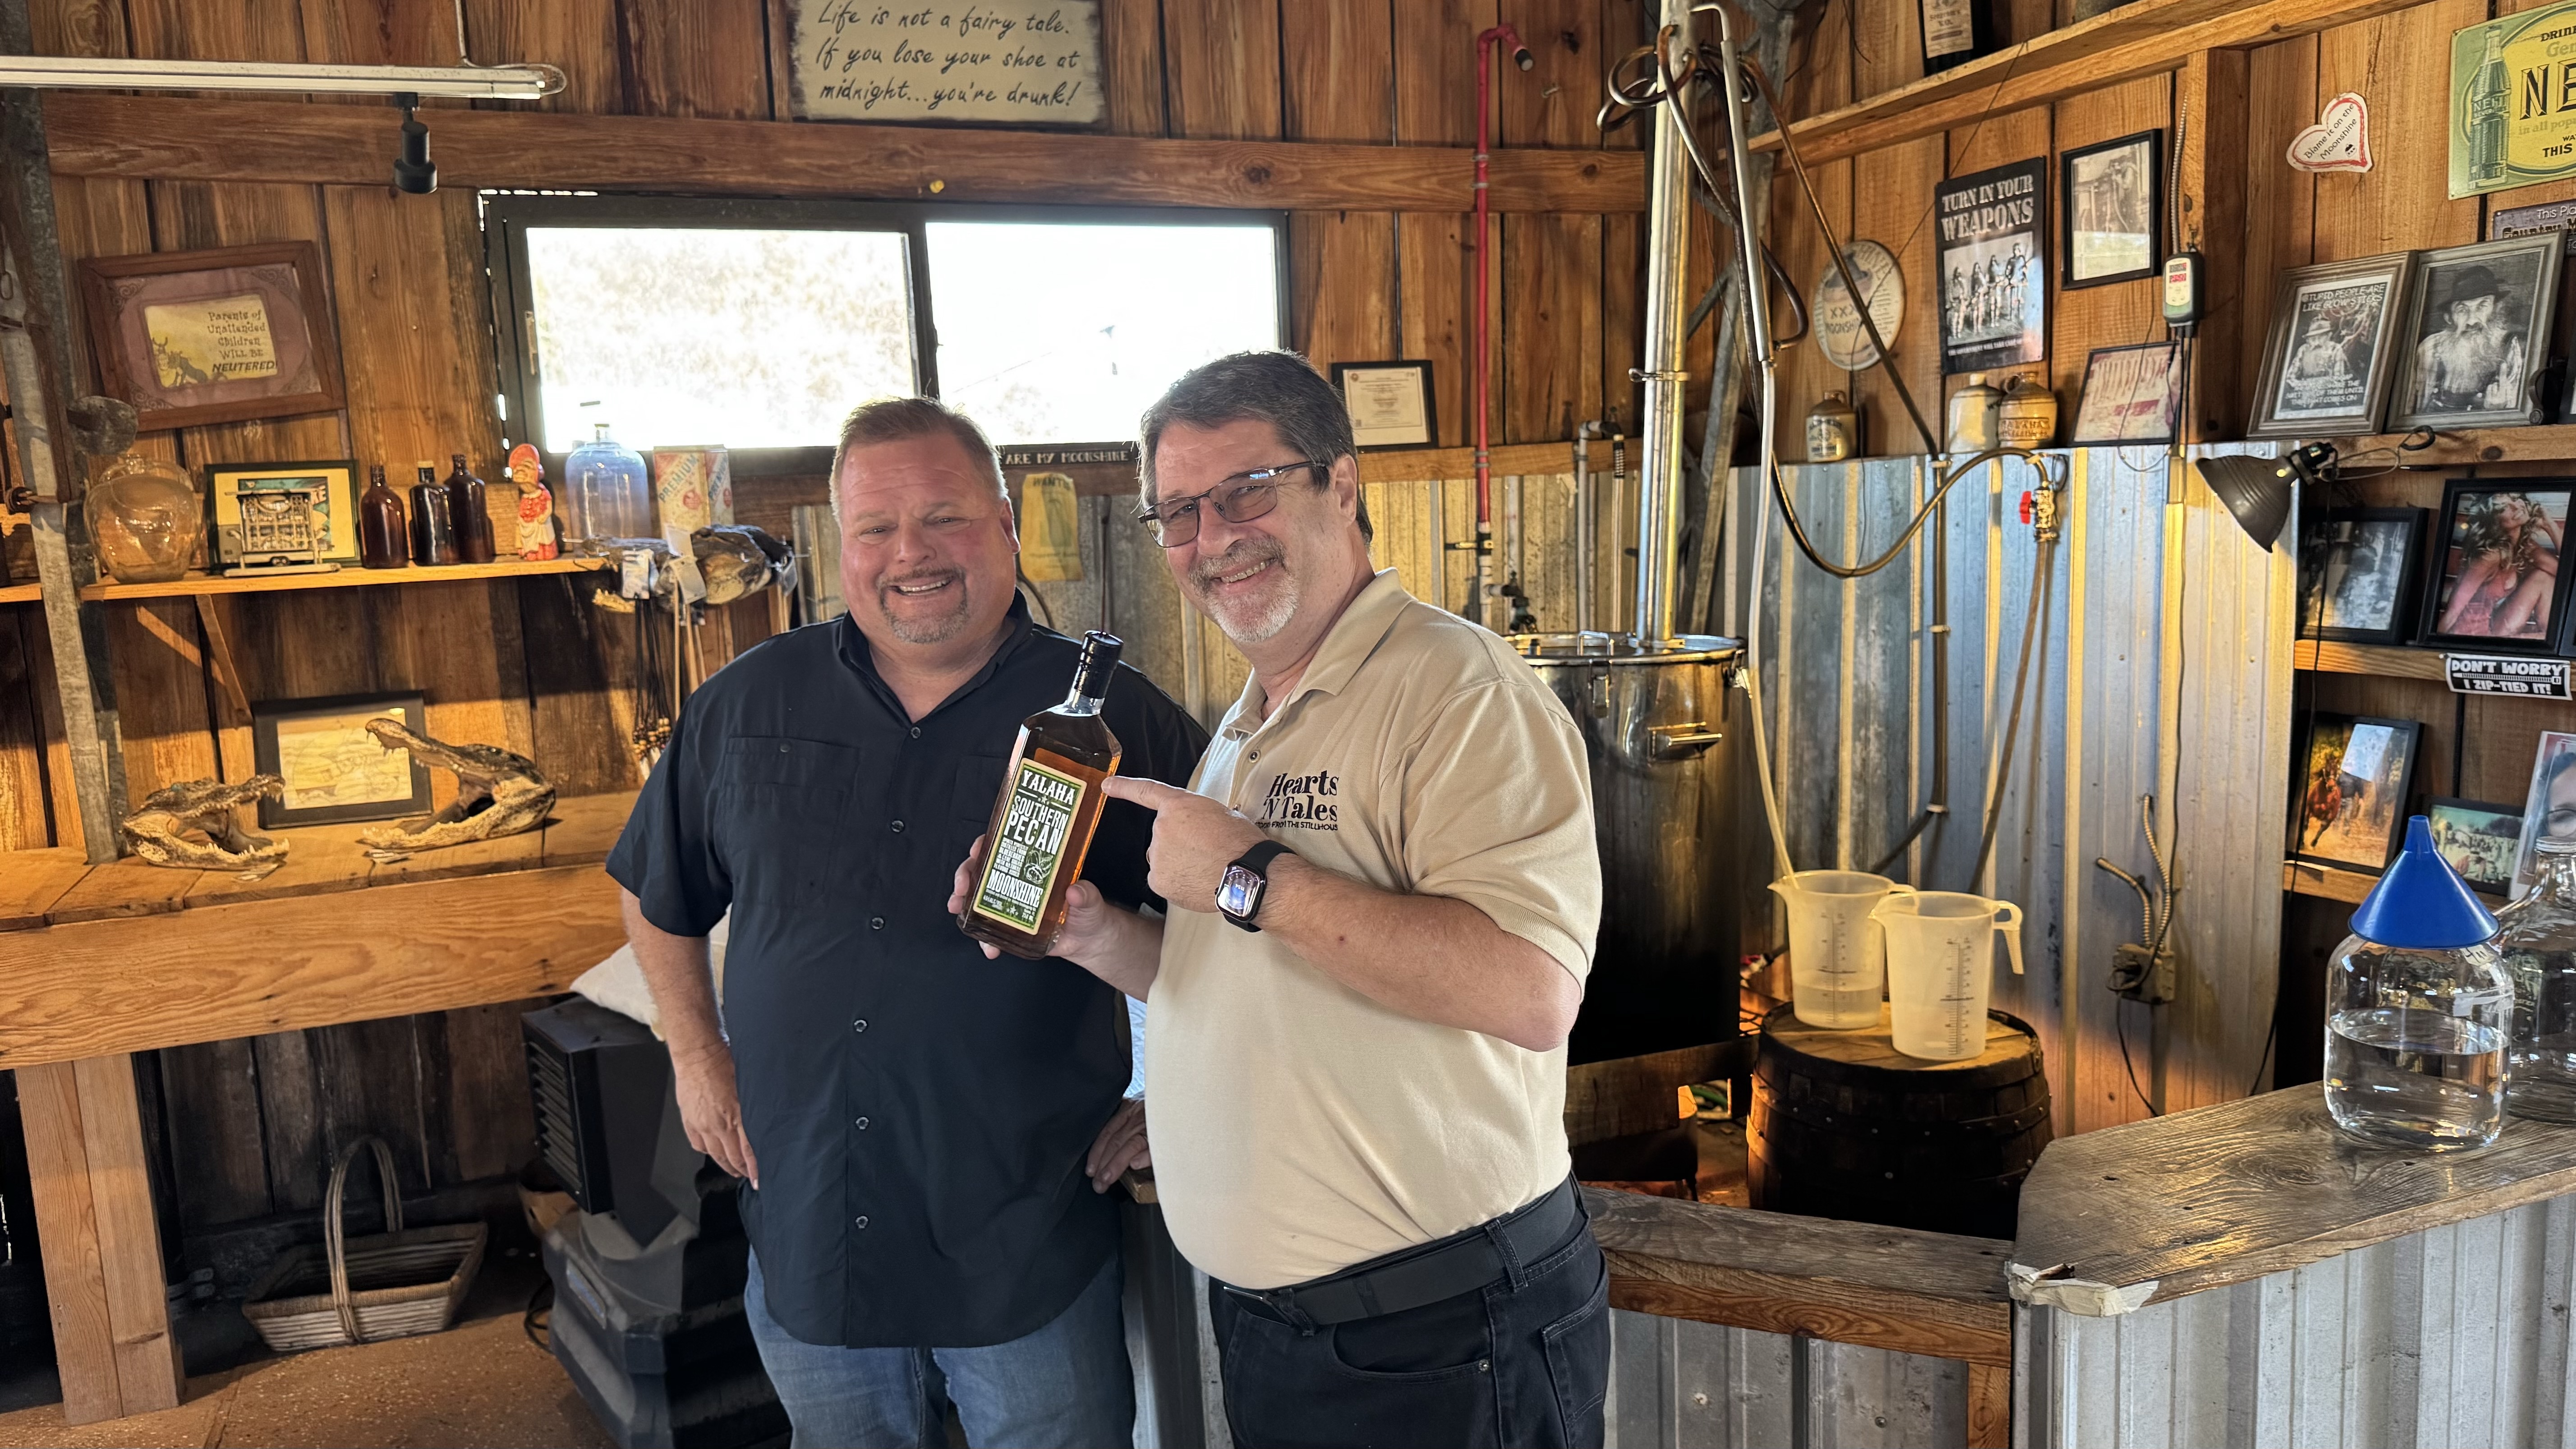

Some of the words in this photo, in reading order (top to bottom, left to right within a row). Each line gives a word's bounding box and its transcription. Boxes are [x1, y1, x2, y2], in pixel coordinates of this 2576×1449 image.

[818, 0, 860, 34] Life
[871, 7, 889, 24] is
[898, 9, 933, 28] not
[941, 15, 950, 28] a
[960, 5, 1016, 40] fairy
[1026, 10, 1069, 33] tale.
[816, 37, 840, 71] If
[843, 49, 882, 73] you
[894, 39, 934, 63] lose
[941, 52, 991, 74] your
[1003, 46, 1046, 68] shoe
[1057, 51, 1081, 68] at
[1007, 81, 1081, 106] drunk!
[2304, 136, 2327, 159] Blame
[2333, 118, 2343, 129] on
[2343, 104, 2354, 117] the
[2320, 119, 2357, 160] Moonshine
[2542, 143, 2572, 157] THIS
[1942, 188, 1977, 212] TURN
[1979, 184, 1994, 203] IN
[1996, 175, 2034, 199] YOUR
[1941, 197, 2034, 241] WEAPONS
[208, 311, 248, 321] Parents
[252, 309, 261, 320] of
[2302, 302, 2322, 312] LIKE
[207, 322, 265, 335] Unattended
[218, 336, 261, 346] Children
[219, 349, 247, 359] WILL
[250, 349, 263, 358] BE
[1005, 454, 1031, 465] ARE
[1037, 453, 1055, 464] MY
[1061, 451, 1128, 463] MOONSHINE
[658, 454, 699, 503] PREMIUM
[2452, 660, 2496, 673] DON'T
[2502, 662, 2563, 676] WORRY
[2464, 679, 2470, 689] I
[2473, 680, 2529, 693] ZIP-TIED
[2533, 683, 2552, 695] IT!
[1021, 769, 1075, 805] YALAHA
[1266, 770, 1339, 798] Hearts
[1012, 795, 1069, 831] SOUTHERN
[1281, 795, 1337, 821] Tales
[1004, 811, 1064, 855] PECAN
[987, 869, 1043, 907] MOONSHINE
